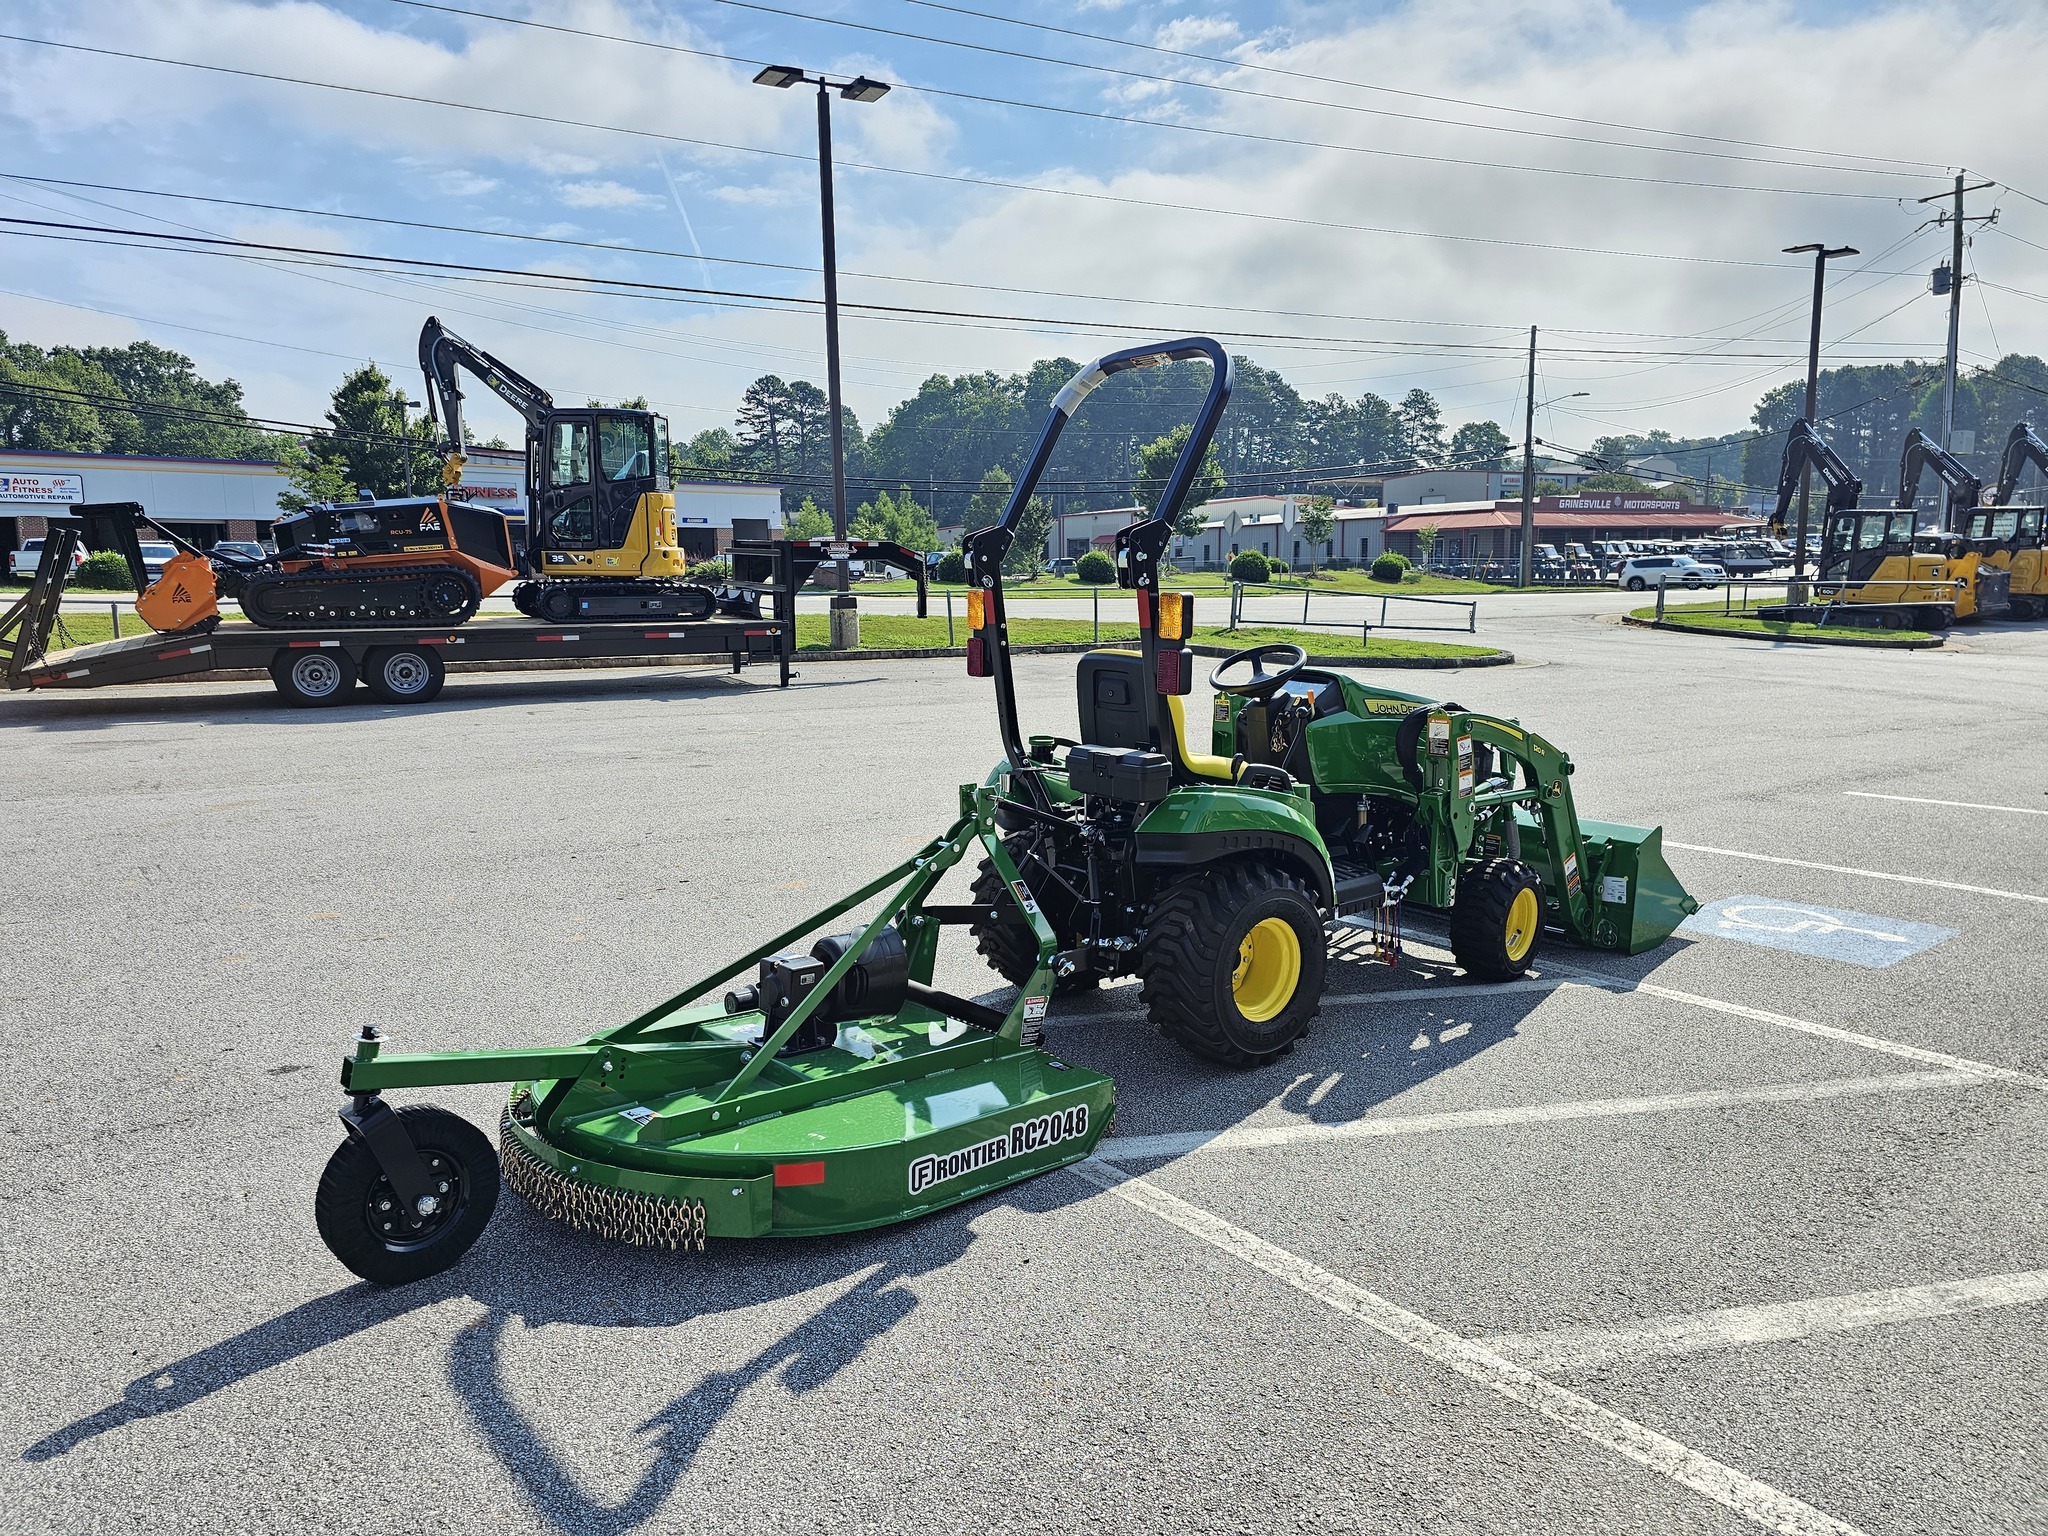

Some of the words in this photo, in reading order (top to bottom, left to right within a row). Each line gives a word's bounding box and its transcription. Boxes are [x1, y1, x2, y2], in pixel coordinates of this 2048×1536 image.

[499, 383, 529, 410] DEERE
[1822, 467, 1839, 487] DEERE
[12, 486, 53, 494] FITNESS
[1559, 500, 1611, 509] GAINESVILLE
[1623, 500, 1680, 510] MOTORSPORTS
[419, 522, 441, 531] FAE
[1374, 703, 1400, 713] JOHN
[910, 1136, 1008, 1193] FRONTIER
[1010, 1105, 1088, 1155] RC2048
